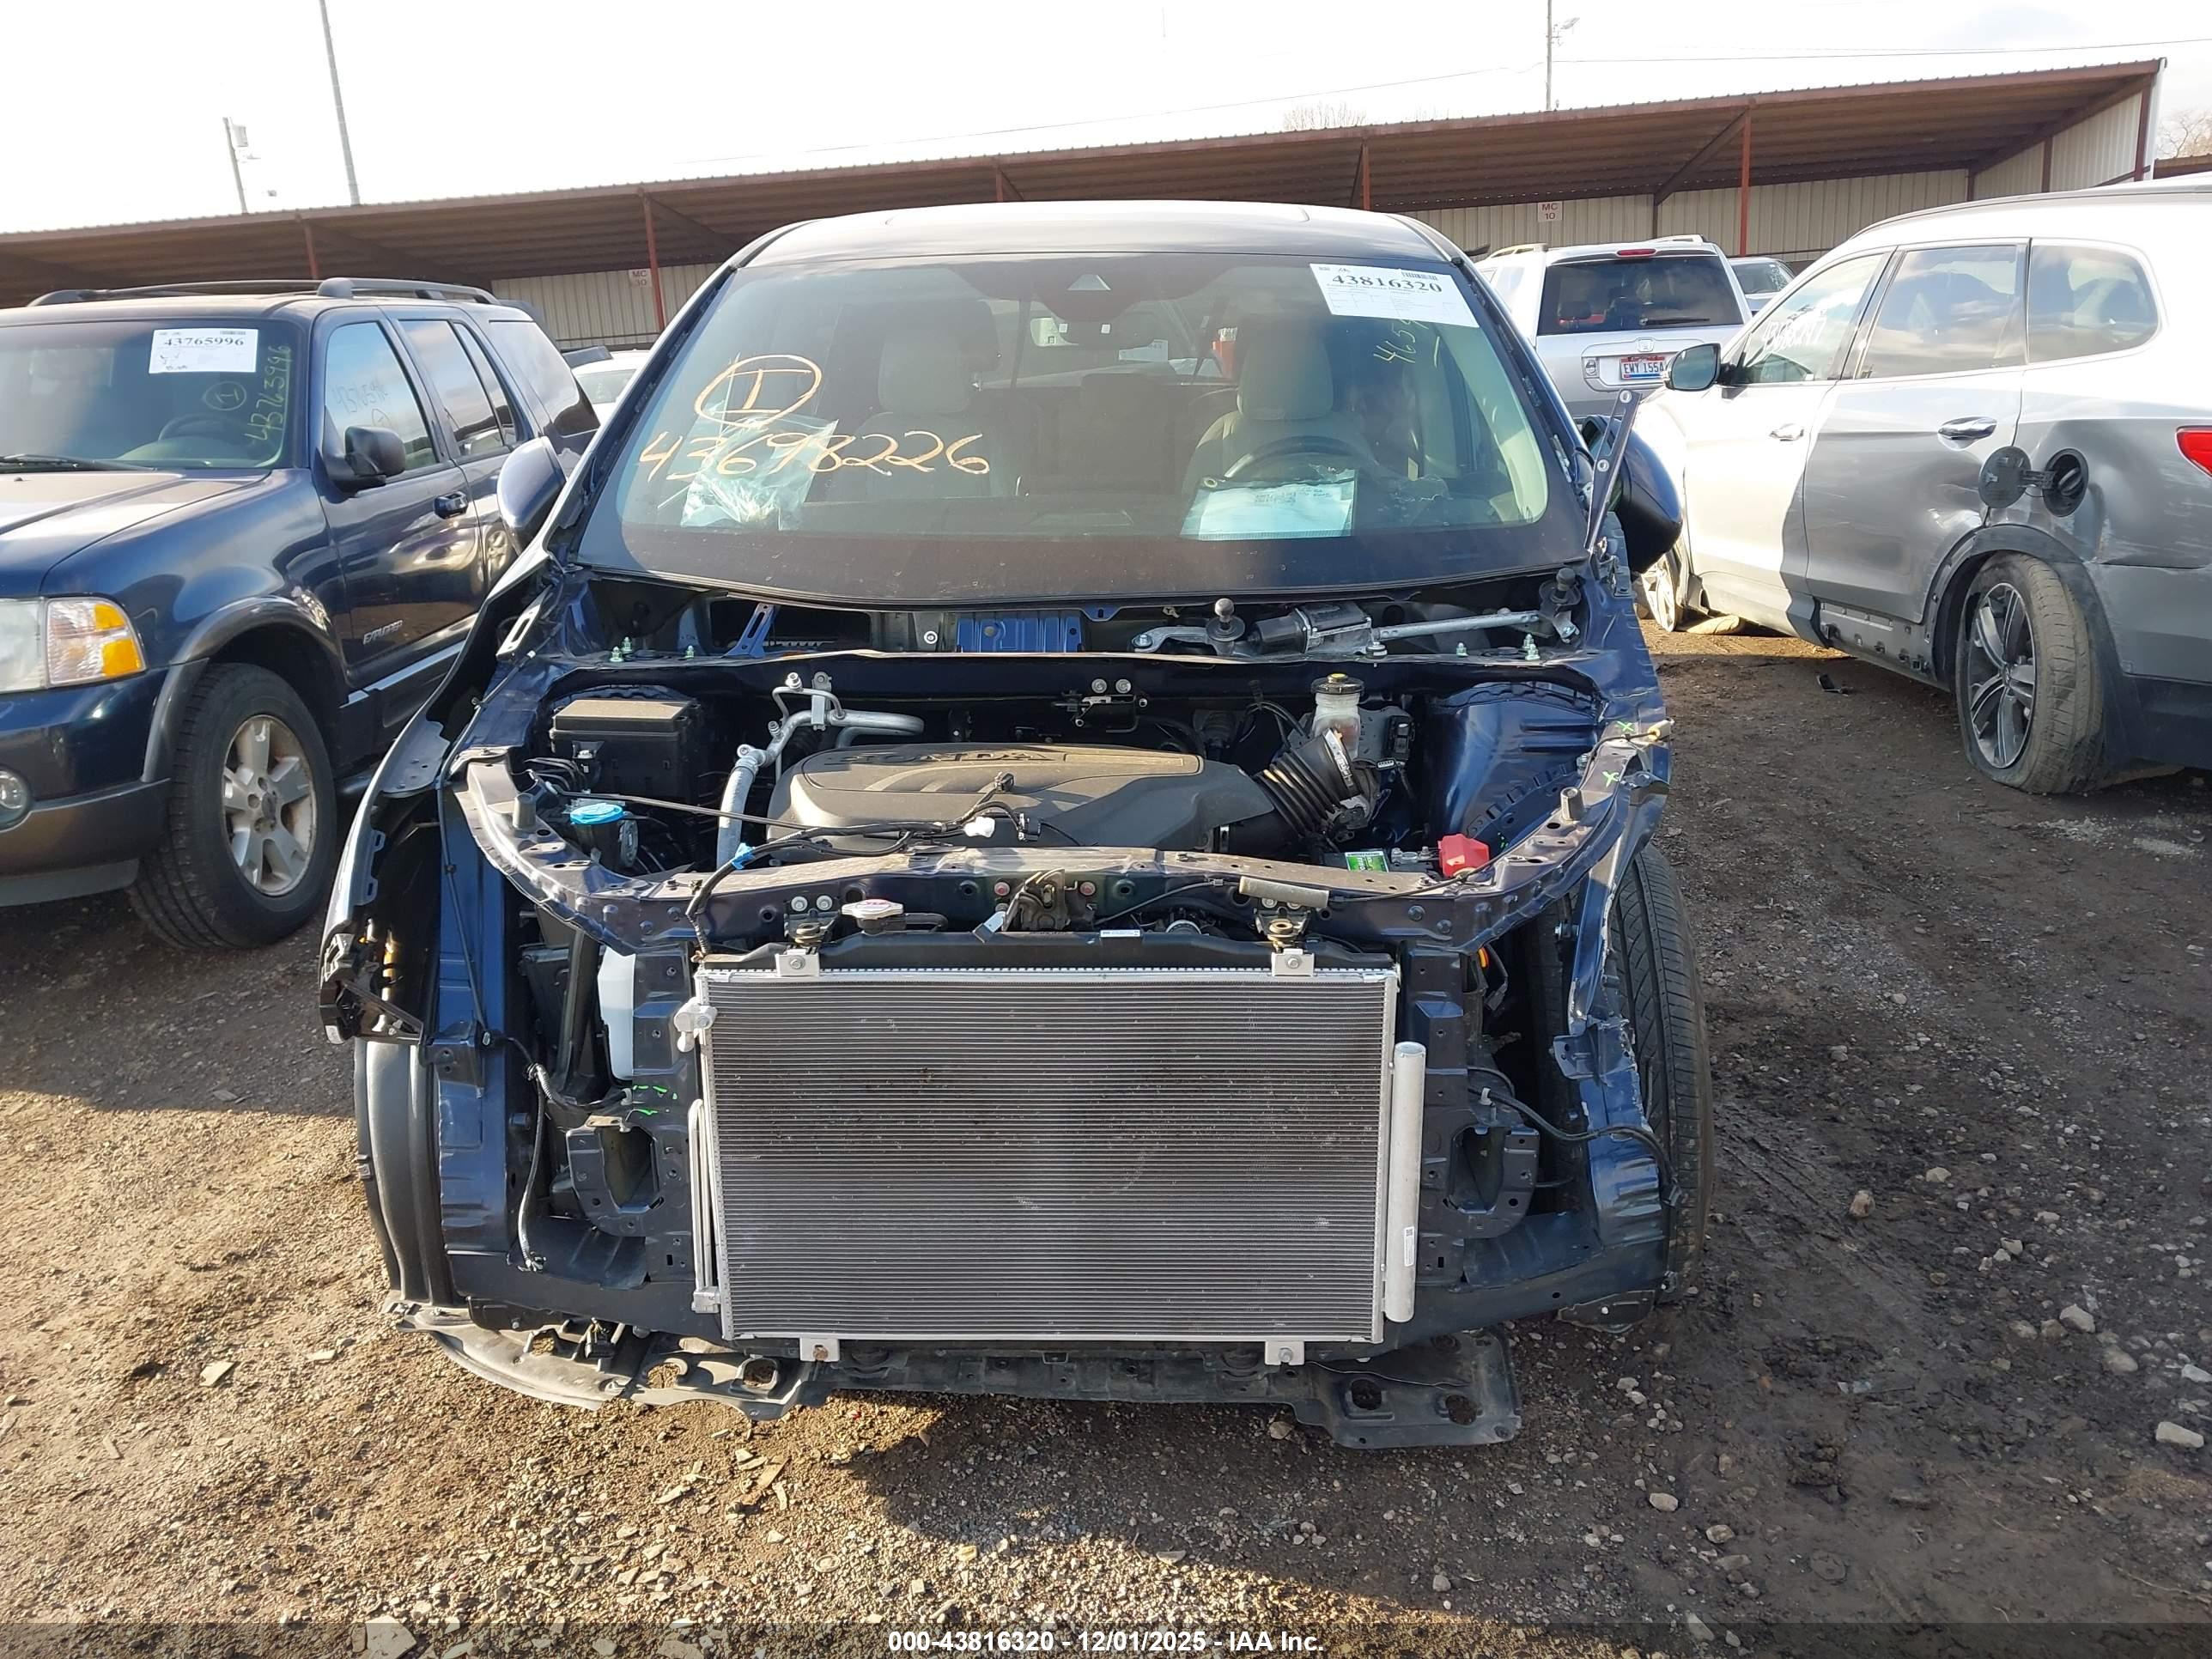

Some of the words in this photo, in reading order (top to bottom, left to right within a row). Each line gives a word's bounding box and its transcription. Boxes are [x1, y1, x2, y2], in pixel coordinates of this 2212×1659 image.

[1541, 203, 1559, 211] MC
[1332, 274, 1443, 294] 43816320
[164, 337, 245, 347] 43765996
[639, 431, 990, 483] 43698226
